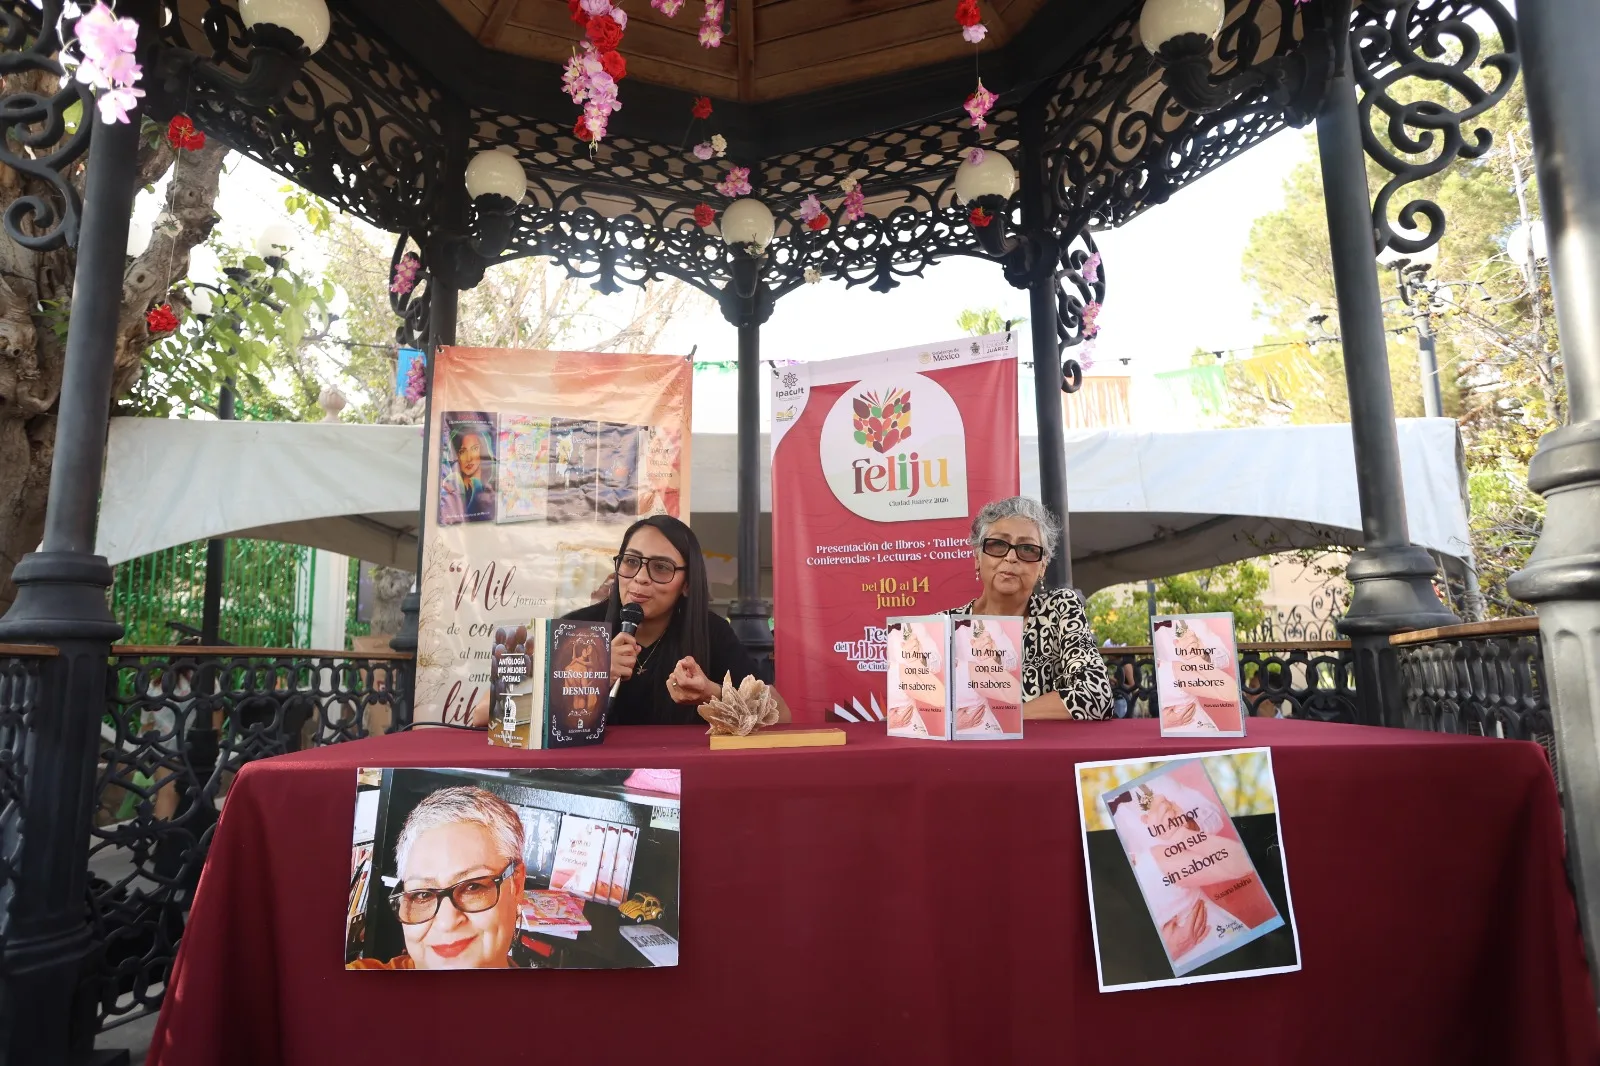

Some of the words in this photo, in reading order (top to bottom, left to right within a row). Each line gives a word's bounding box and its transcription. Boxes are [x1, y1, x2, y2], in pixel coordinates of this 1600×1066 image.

[932, 352, 960, 362] México
[852, 452, 952, 498] feliju
[816, 541, 879, 554] Presentación
[881, 539, 893, 550] de
[895, 538, 926, 550] libros
[806, 553, 870, 566] Conferencias
[877, 550, 922, 563] Lecturas
[861, 582, 878, 592] Del
[879, 577, 897, 594] 10
[900, 581, 910, 591] al
[912, 576, 930, 593] 14
[514, 595, 547, 609] formas
[876, 593, 916, 610] junio
[446, 622, 461, 635] de
[835, 643, 848, 651] del
[971, 647, 983, 657] Un
[983, 647, 1007, 657] Amor
[1174, 647, 1188, 656] Un
[1189, 646, 1216, 656] Amor
[459, 646, 471, 660] al
[901, 650, 911, 659] Un
[912, 650, 932, 659] Amor
[507, 666, 527, 674] MEJORES
[858, 662, 867, 670] de
[904, 667, 917, 675] con
[917, 667, 930, 675] sus
[974, 664, 990, 673] con
[990, 664, 1004, 673] sus
[1180, 663, 1197, 672] con
[1198, 663, 1215, 671] sus
[501, 675, 521, 683] POEMAS
[553, 669, 583, 679] SUEÑOS
[583, 671, 593, 679] DE
[593, 671, 608, 679] PIEL
[898, 682, 908, 691] sin
[908, 681, 937, 691] sabores
[967, 680, 979, 689] sin
[979, 679, 1012, 689] sabores
[1173, 679, 1186, 688] sin
[1187, 678, 1225, 688] sabores
[562, 686, 600, 696] DESNUDA
[1147, 823, 1166, 838] Un
[1167, 806, 1200, 831] Amor
[1163, 840, 1188, 858] con
[1186, 830, 1208, 847] sus
[1162, 871, 1182, 887] sin
[1180, 848, 1230, 878] sabores
[1232, 877, 1253, 892] Molina
